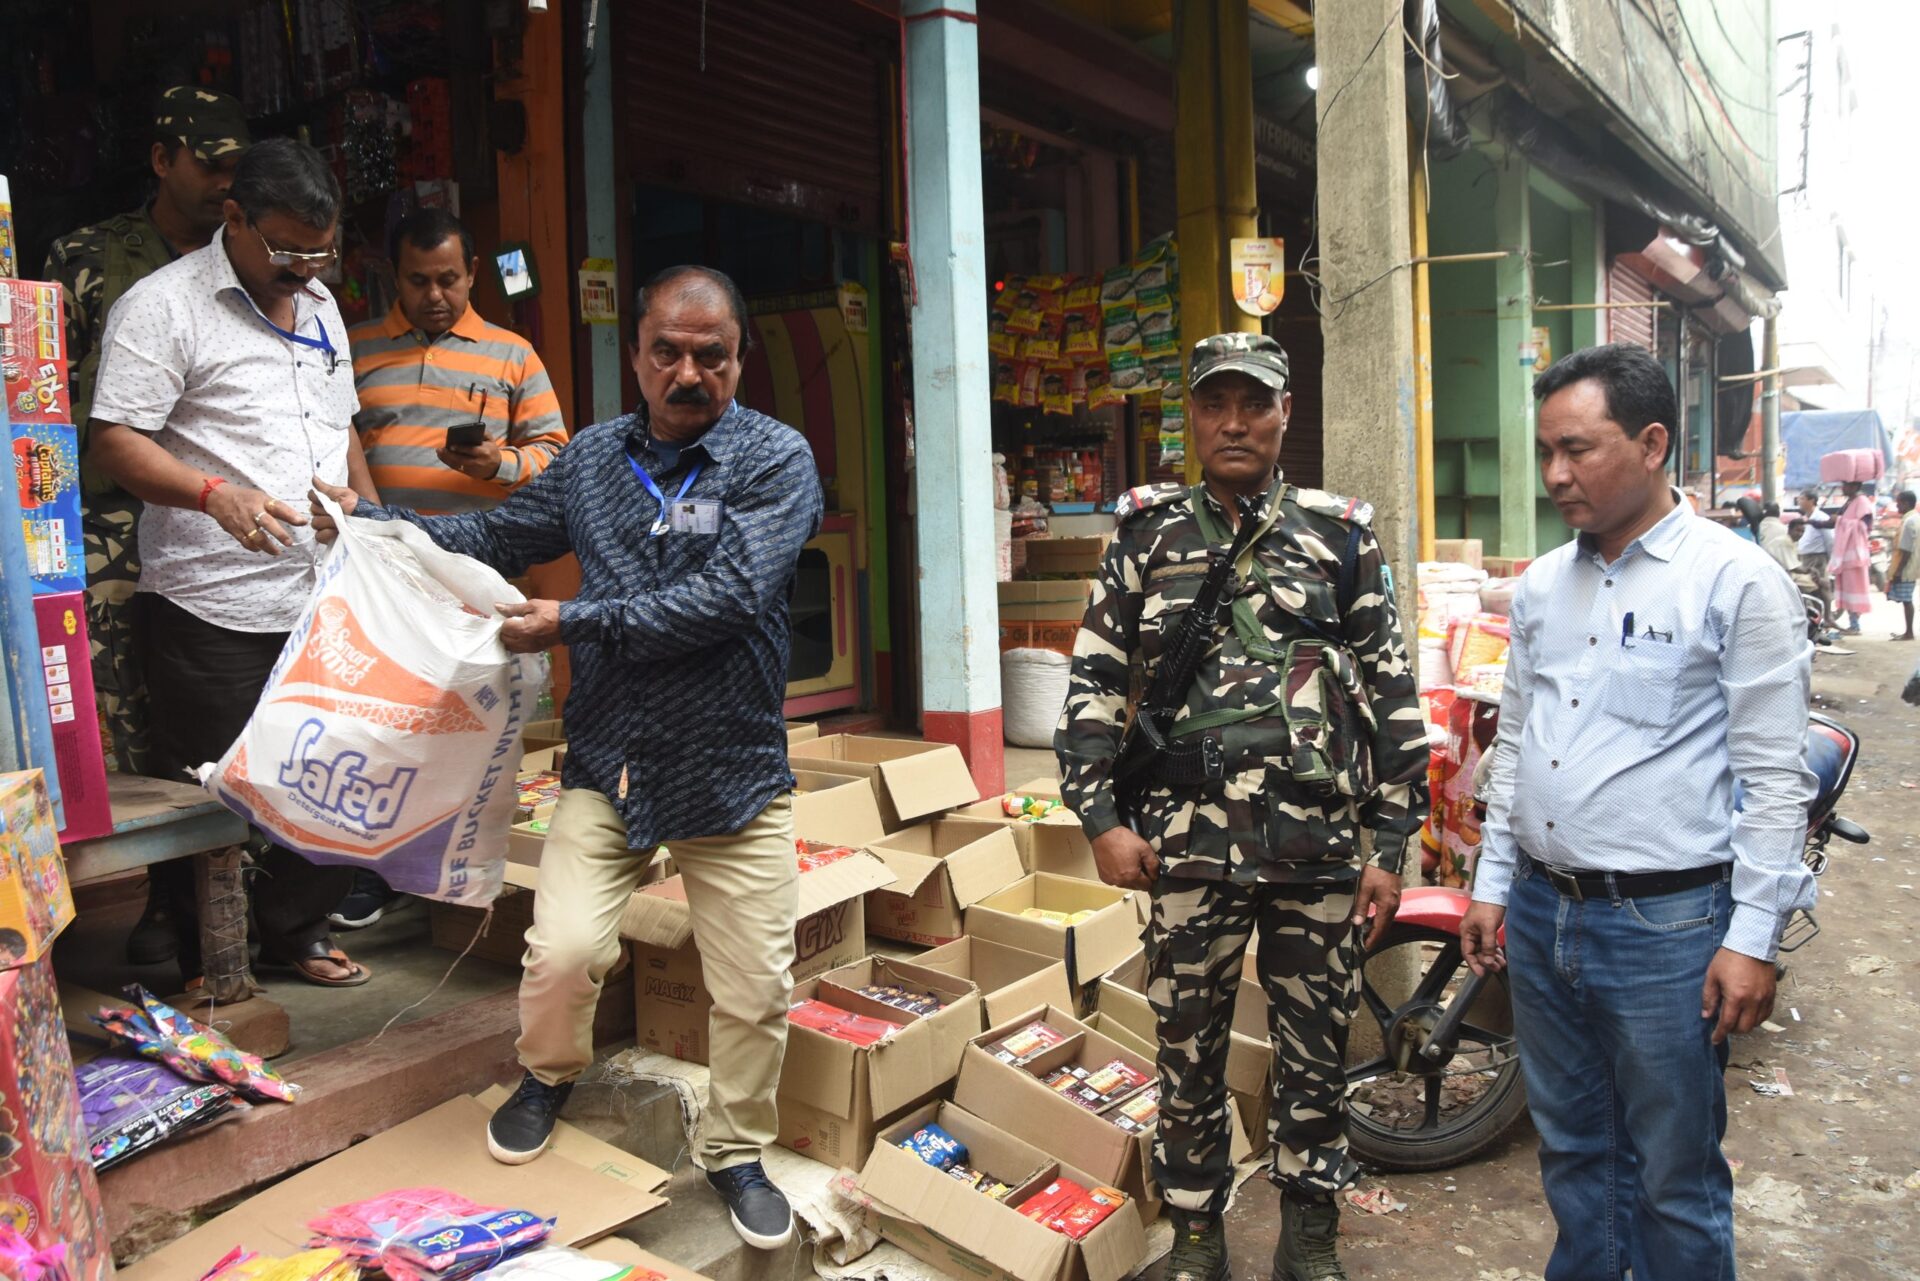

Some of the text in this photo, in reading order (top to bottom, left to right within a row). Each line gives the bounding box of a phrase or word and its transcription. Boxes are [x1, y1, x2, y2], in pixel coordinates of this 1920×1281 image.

[332, 627, 379, 673] Smart
[1043, 627, 1070, 643] Coin
[473, 684, 501, 713] NEW
[492, 688, 523, 761] WITH
[278, 717, 419, 831] Safed
[287, 791, 380, 841] Detergent Powder
[456, 764, 502, 852] BUCKET
[444, 856, 470, 899] REE
[645, 976, 697, 1003] MAGIX
